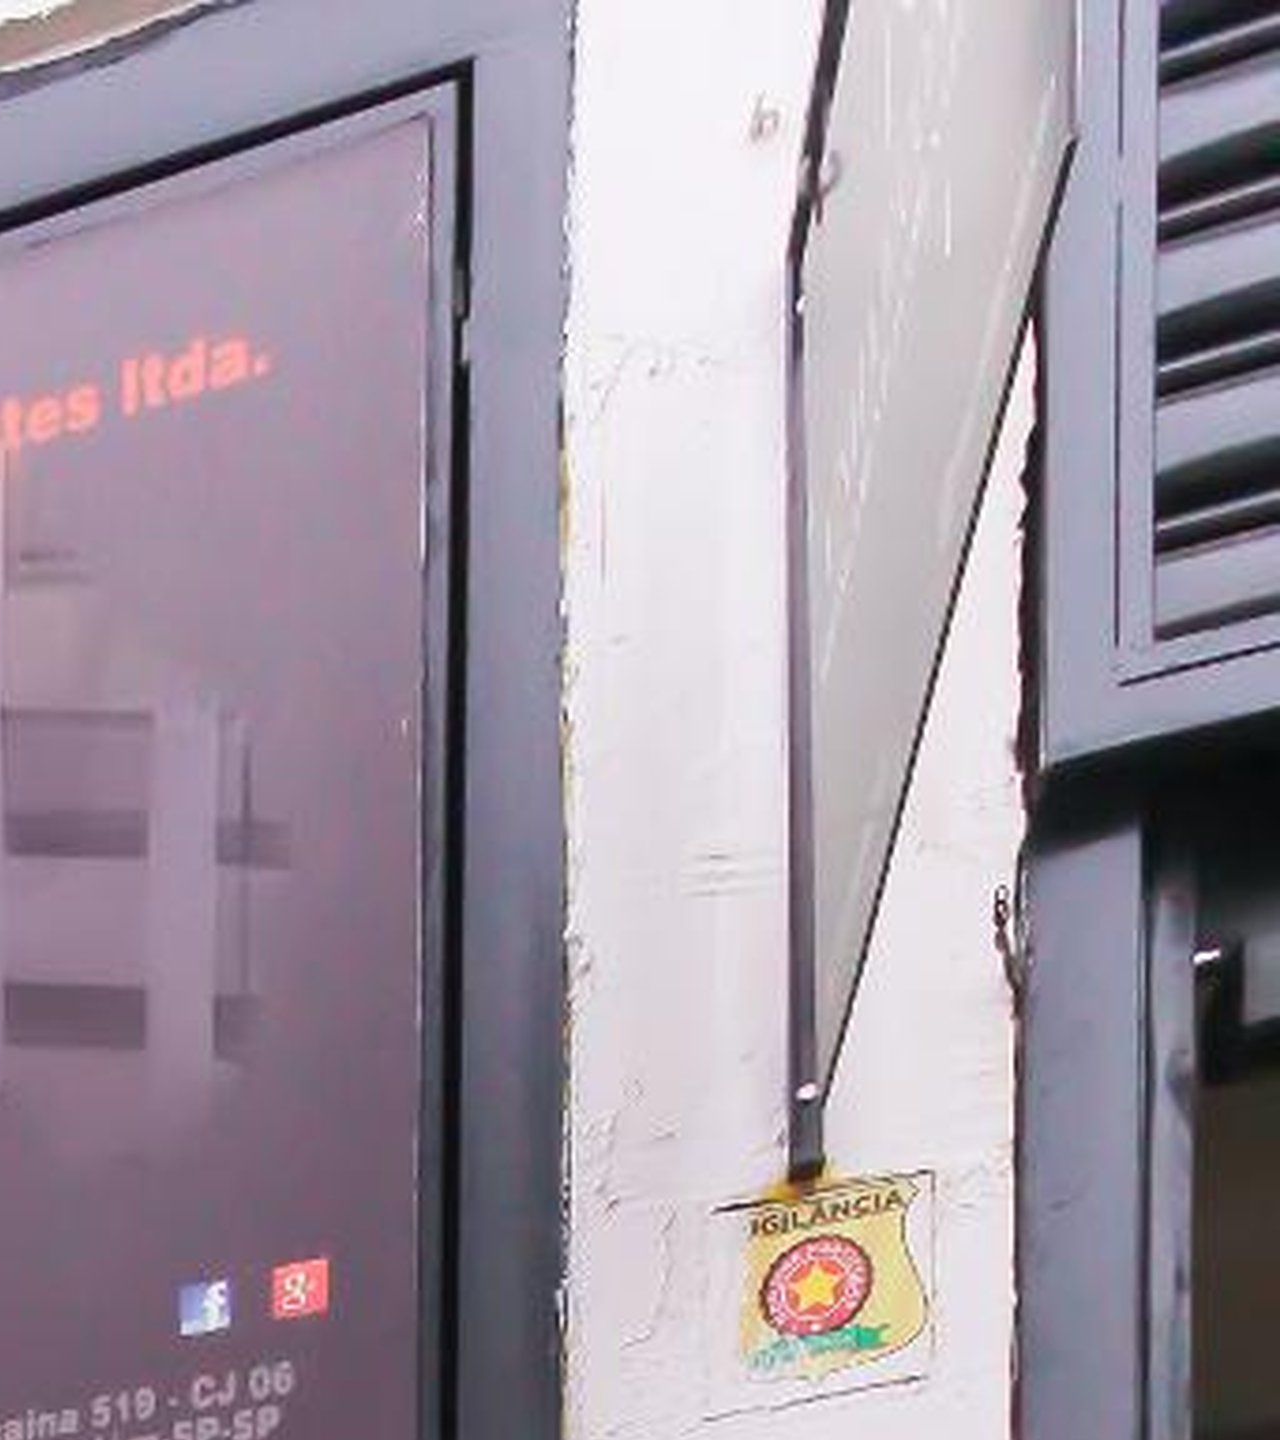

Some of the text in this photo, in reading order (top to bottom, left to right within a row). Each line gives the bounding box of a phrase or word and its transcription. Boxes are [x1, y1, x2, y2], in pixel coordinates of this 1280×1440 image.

[119, 337, 270, 415] ltda.
[91, 1386, 157, 1429] 519
[192, 1369, 238, 1409] CJ
[247, 1360, 296, 1400] 06
